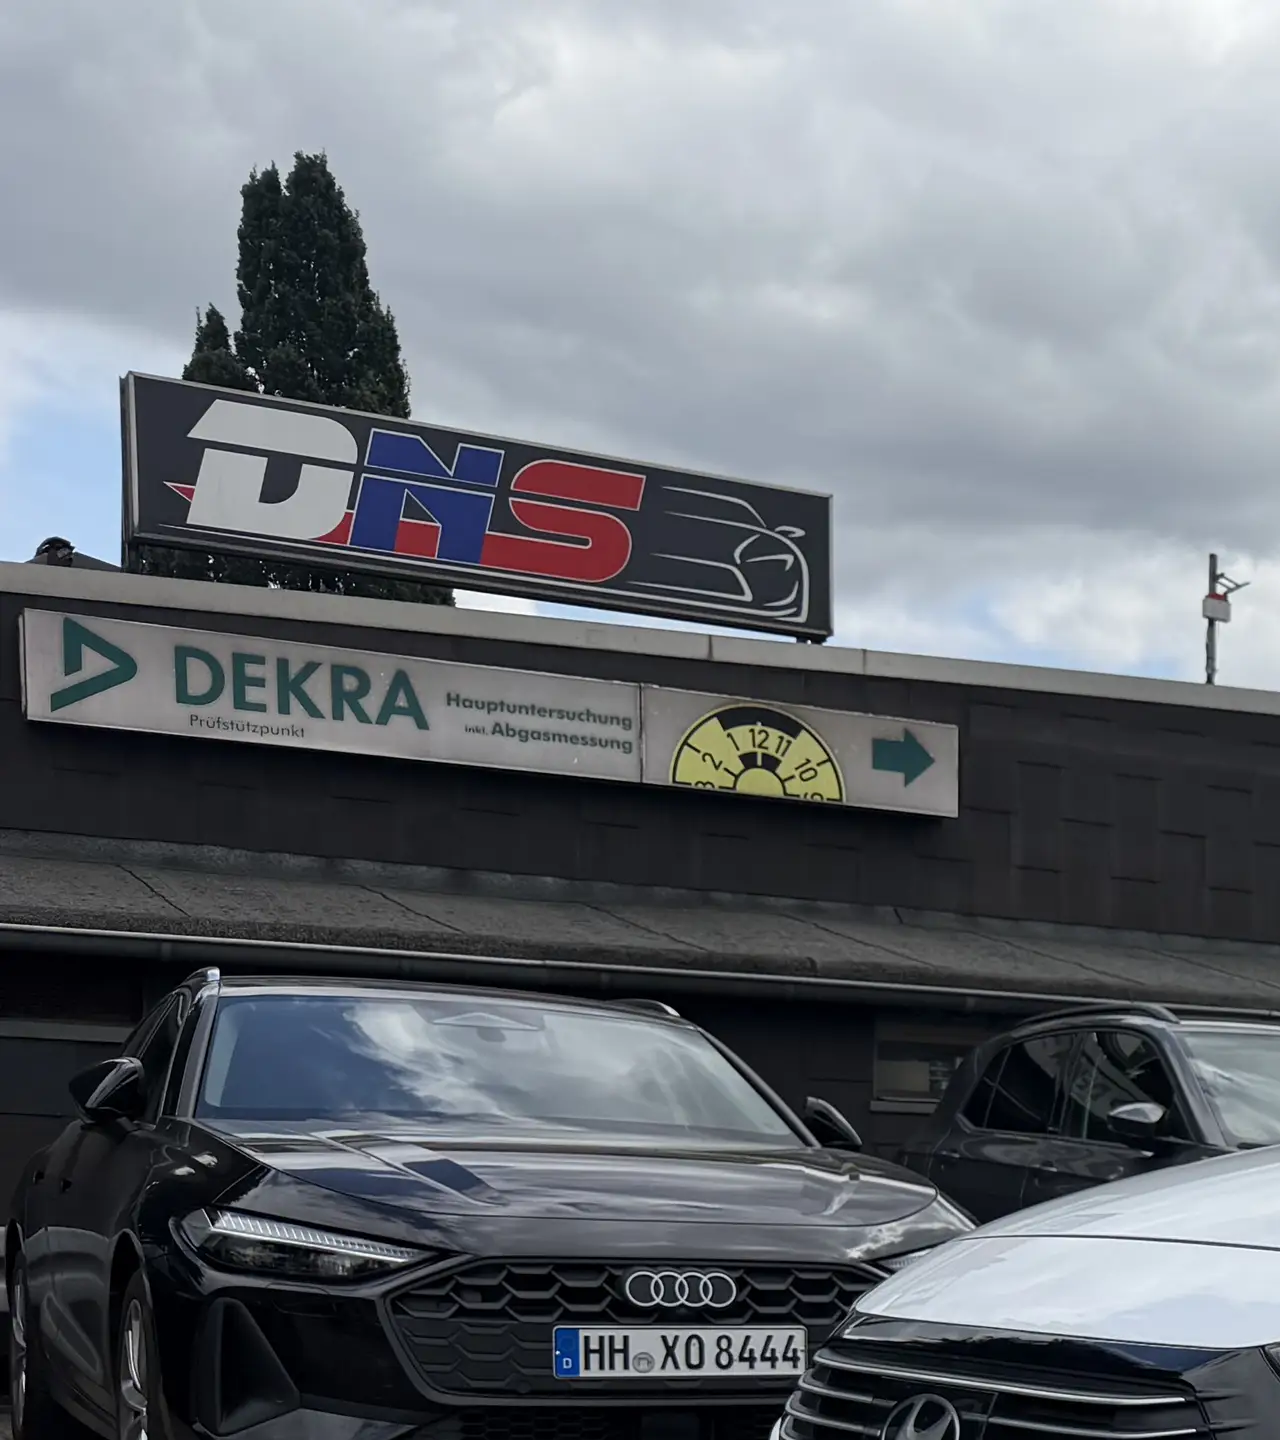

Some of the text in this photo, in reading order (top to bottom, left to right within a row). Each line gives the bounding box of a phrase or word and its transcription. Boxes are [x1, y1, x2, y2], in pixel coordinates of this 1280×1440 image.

[186, 398, 647, 583] DNS
[174, 645, 430, 731] DEKRA
[189, 713, 305, 738] Prüfstützpunkt
[446, 692, 632, 731] Hauptuntersuchung
[465, 722, 634, 755] inkl. Abgasmessung
[701, 728, 818, 782] 2 1 12 11 10
[583, 1334, 801, 1371] HH XO 8444
